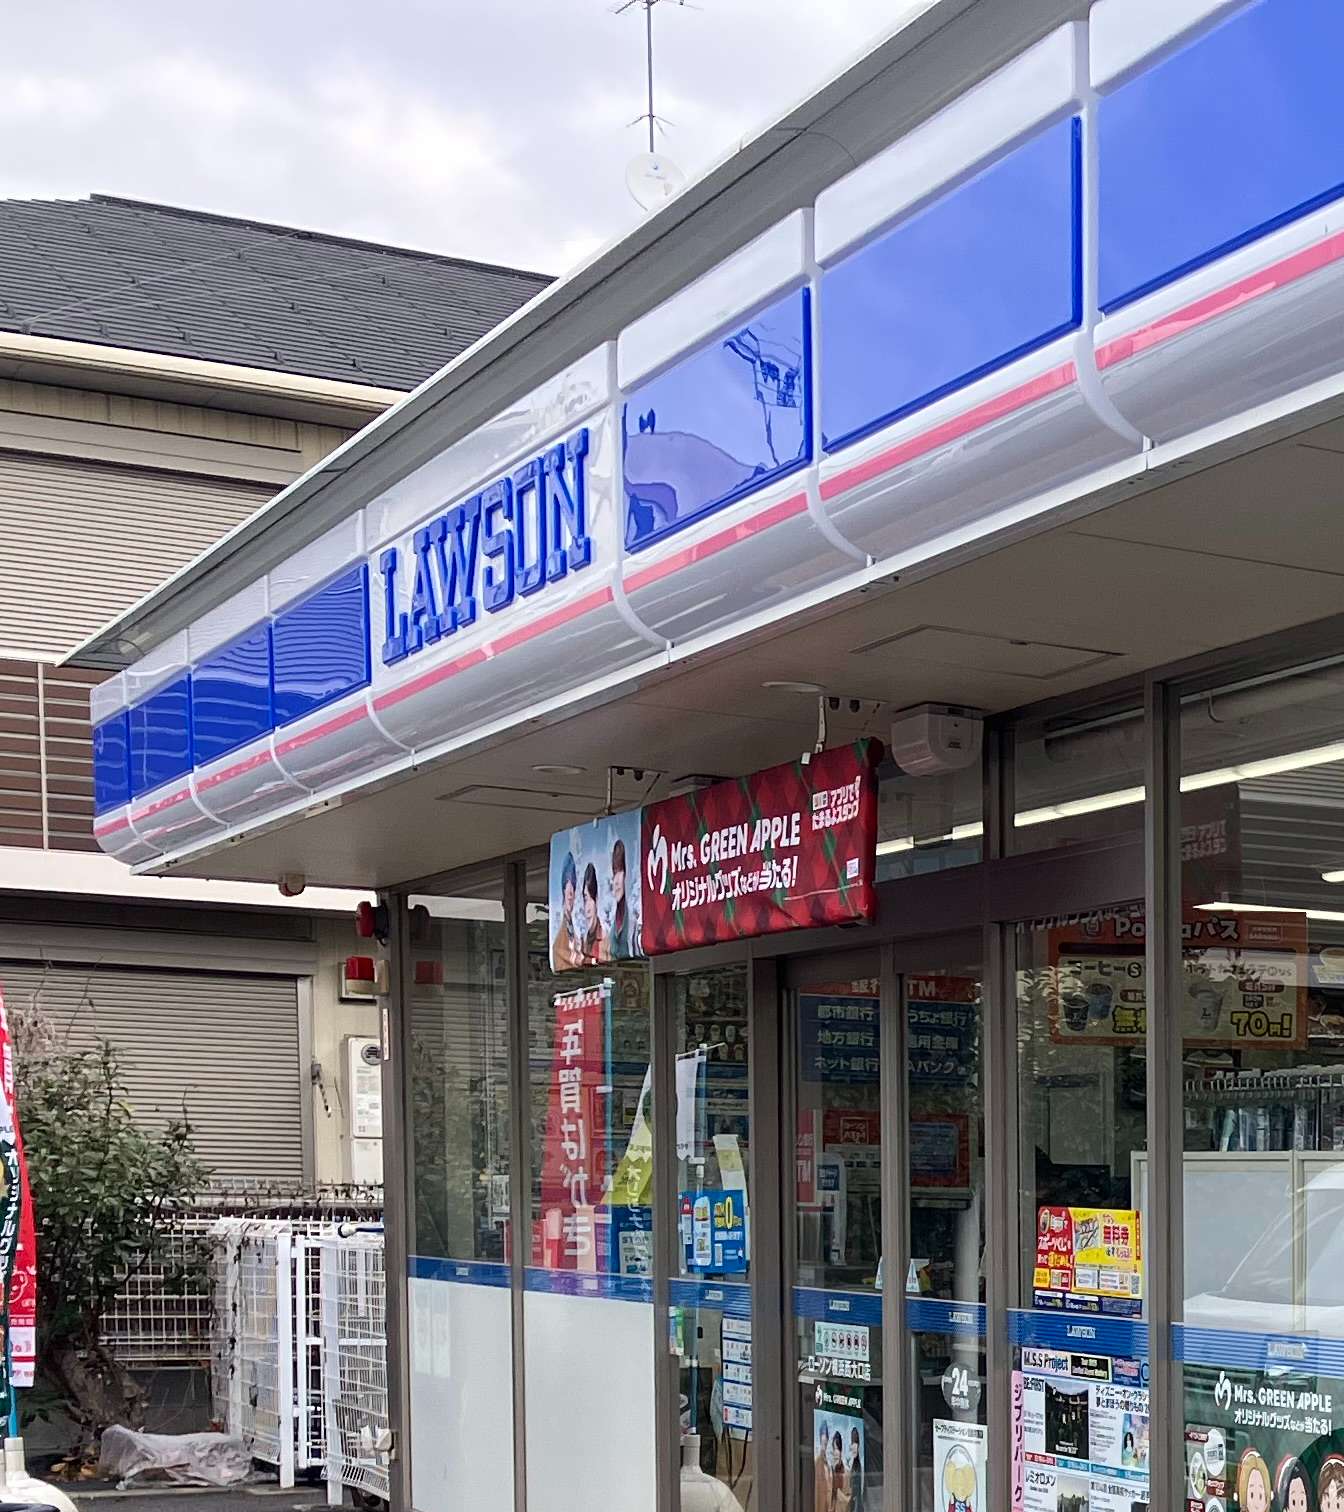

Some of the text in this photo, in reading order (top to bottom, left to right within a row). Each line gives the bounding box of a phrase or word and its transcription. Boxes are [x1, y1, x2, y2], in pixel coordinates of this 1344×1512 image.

[379, 427, 592, 667] LAWSON
[671, 812, 801, 873] Mrs. GREEN APPLE
[951, 1367, 969, 1397] 24
[1234, 1384, 1333, 1413] Mrs. GREEN APPLE
[1013, 1383, 1025, 1503] ジブリパーク
[1025, 1470, 1056, 1488] レミオロメン
